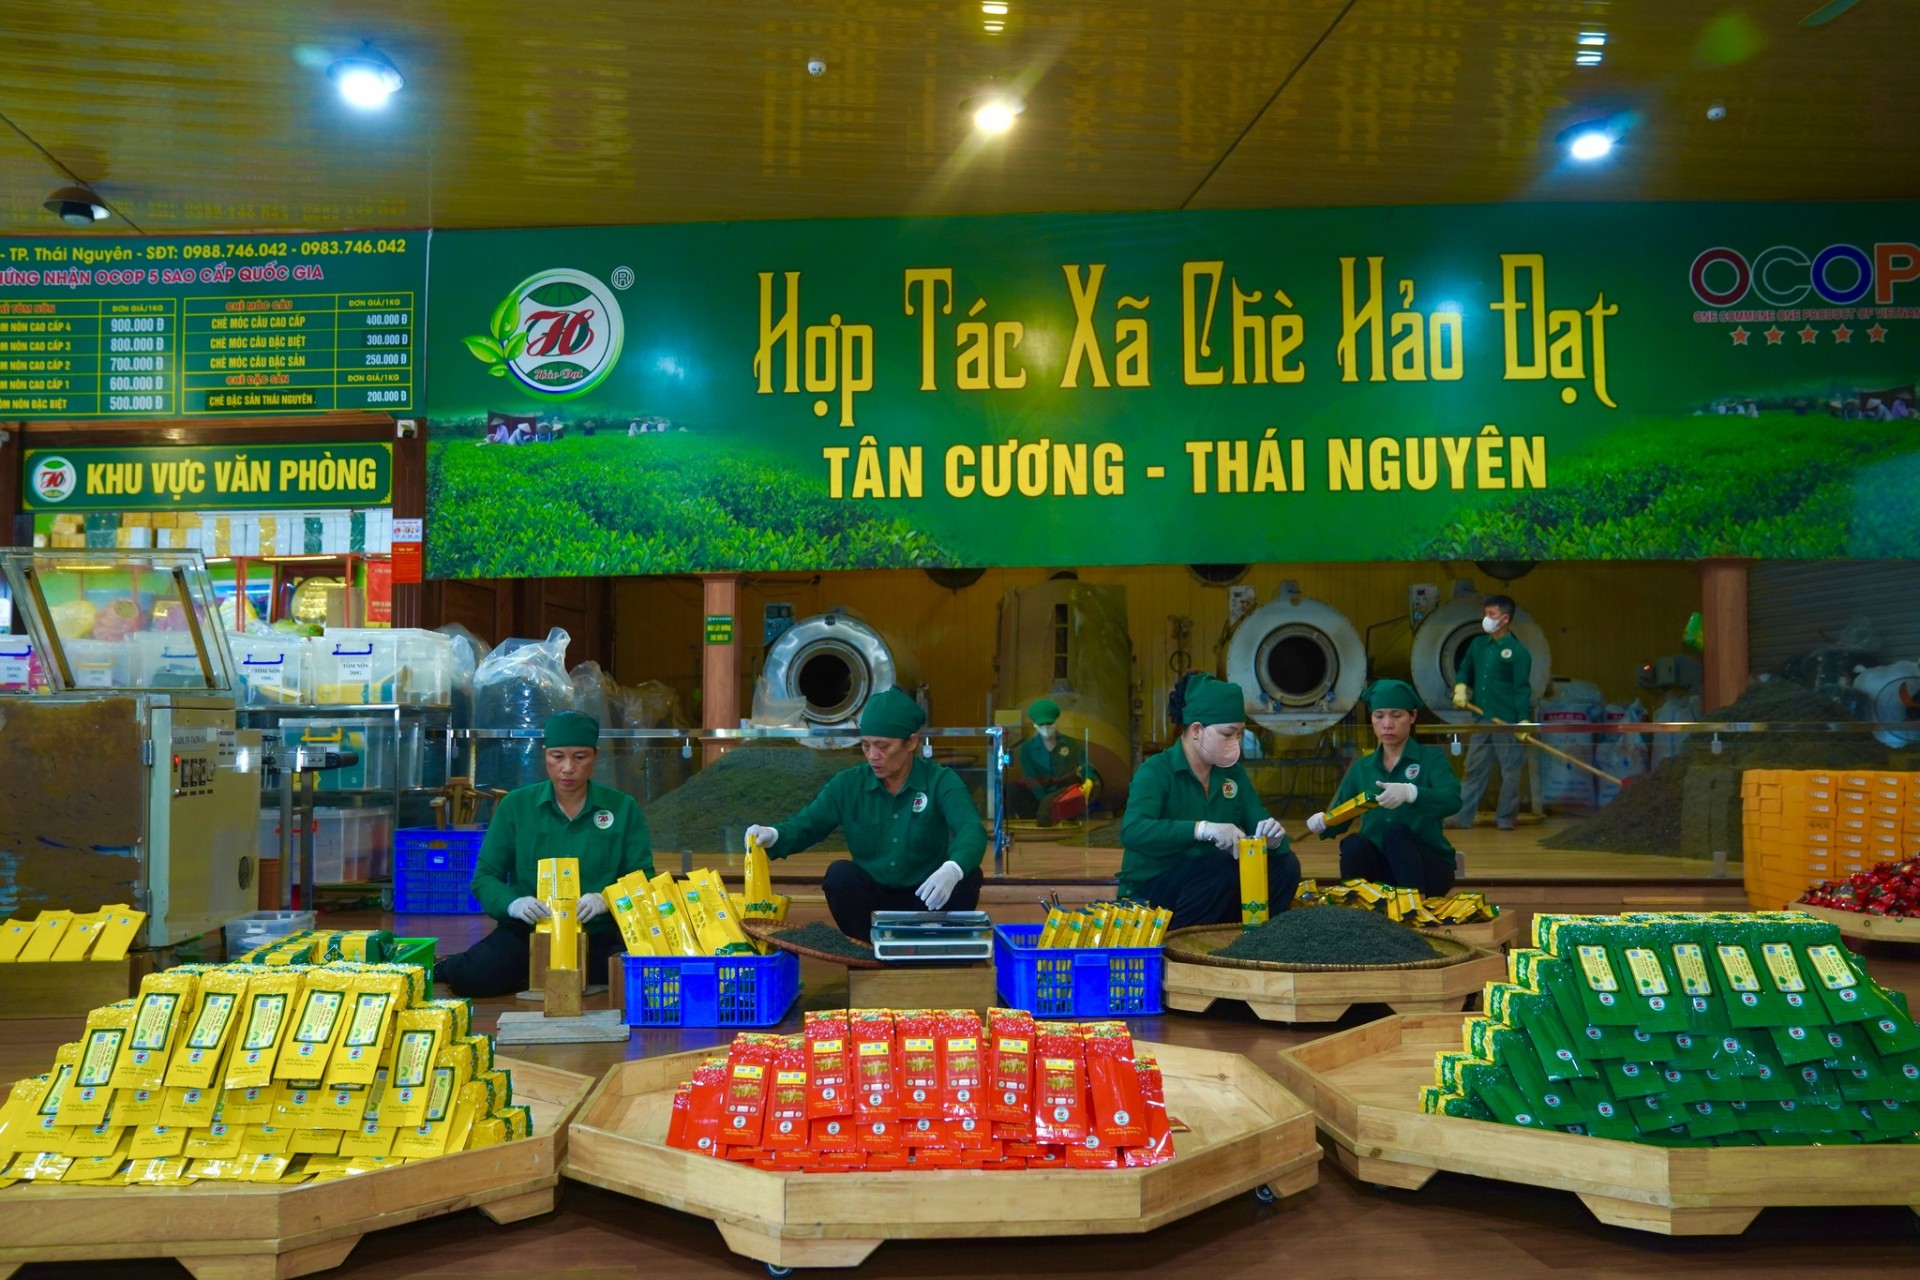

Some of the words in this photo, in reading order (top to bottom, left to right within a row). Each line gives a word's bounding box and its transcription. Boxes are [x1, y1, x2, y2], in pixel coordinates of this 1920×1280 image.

[9, 247, 29, 261] TP.
[34, 246, 67, 261] Thái
[72, 246, 132, 264] Nguyên
[146, 246, 178, 260] SĐT:
[183, 243, 287, 259] 0988.746.042
[301, 239, 406, 255] 0983.746.042
[44, 266, 91, 289] NHẬN
[95, 269, 144, 285] OCOP
[148, 269, 158, 284] 5
[162, 268, 196, 284] SAO
[200, 262, 235, 283] CẤP
[238, 260, 289, 282] QUỐC
[293, 264, 324, 281] GIA
[1689, 242, 1920, 309] OCOP
[367, 297, 400, 306] GIÁ/1KG
[211, 316, 227, 329] CHÈ
[230, 316, 249, 329] MÓC
[251, 315, 268, 328] CÂU
[270, 317, 286, 328] CAO
[288, 313, 305, 327] CẤP
[366, 314, 399, 325] 400.000
[1693, 311, 1717, 322] ONE
[1777, 310, 1800, 321] ONE
[1802, 309, 1856, 320] PRODUCT
[1857, 308, 1873, 320] OF
[111, 318, 154, 332] 900.000
[110, 337, 153, 351] 800.000
[210, 336, 226, 349] CHÈ
[229, 336, 247, 348] MÓC
[250, 335, 267, 348] CÂU
[269, 335, 286, 350] ĐẶC
[288, 334, 306, 349] BIỆT
[366, 334, 400, 345] 300.000
[753, 271, 874, 427] Hợp
[905, 268, 1027, 391] Tác
[1059, 263, 1151, 389] Xã
[1182, 261, 1305, 386] Chè
[1337, 256, 1464, 382] Hảo
[1490, 253, 1619, 408] Đạt
[110, 357, 153, 371] 700.000
[210, 356, 226, 368] CHÈ
[229, 355, 247, 368] MÓC
[250, 354, 267, 367] CÂU
[269, 354, 286, 369] ĐẶC
[288, 353, 305, 366] SẢN
[365, 354, 399, 365] 250.000
[110, 376, 153, 390] 600.000
[366, 373, 400, 381] GIÁ/1KG
[109, 396, 152, 410] 500.000
[209, 394, 224, 406] CHÈ
[244, 393, 260, 405] SẢN
[262, 393, 279, 405] THÁI
[282, 392, 312, 405] NGUYÊN
[367, 391, 399, 402] 200.000
[823, 435, 923, 499] TÂN
[945, 438, 1124, 498] CƯƠNG
[1147, 466, 1165, 478] -
[1185, 428, 1305, 494] THÁI
[1328, 425, 1547, 491] NGUYÊN
[86, 463, 143, 495] KHU
[151, 459, 205, 500] VỰC
[214, 453, 270, 494] VĂN
[279, 451, 376, 491] PHÒNG
